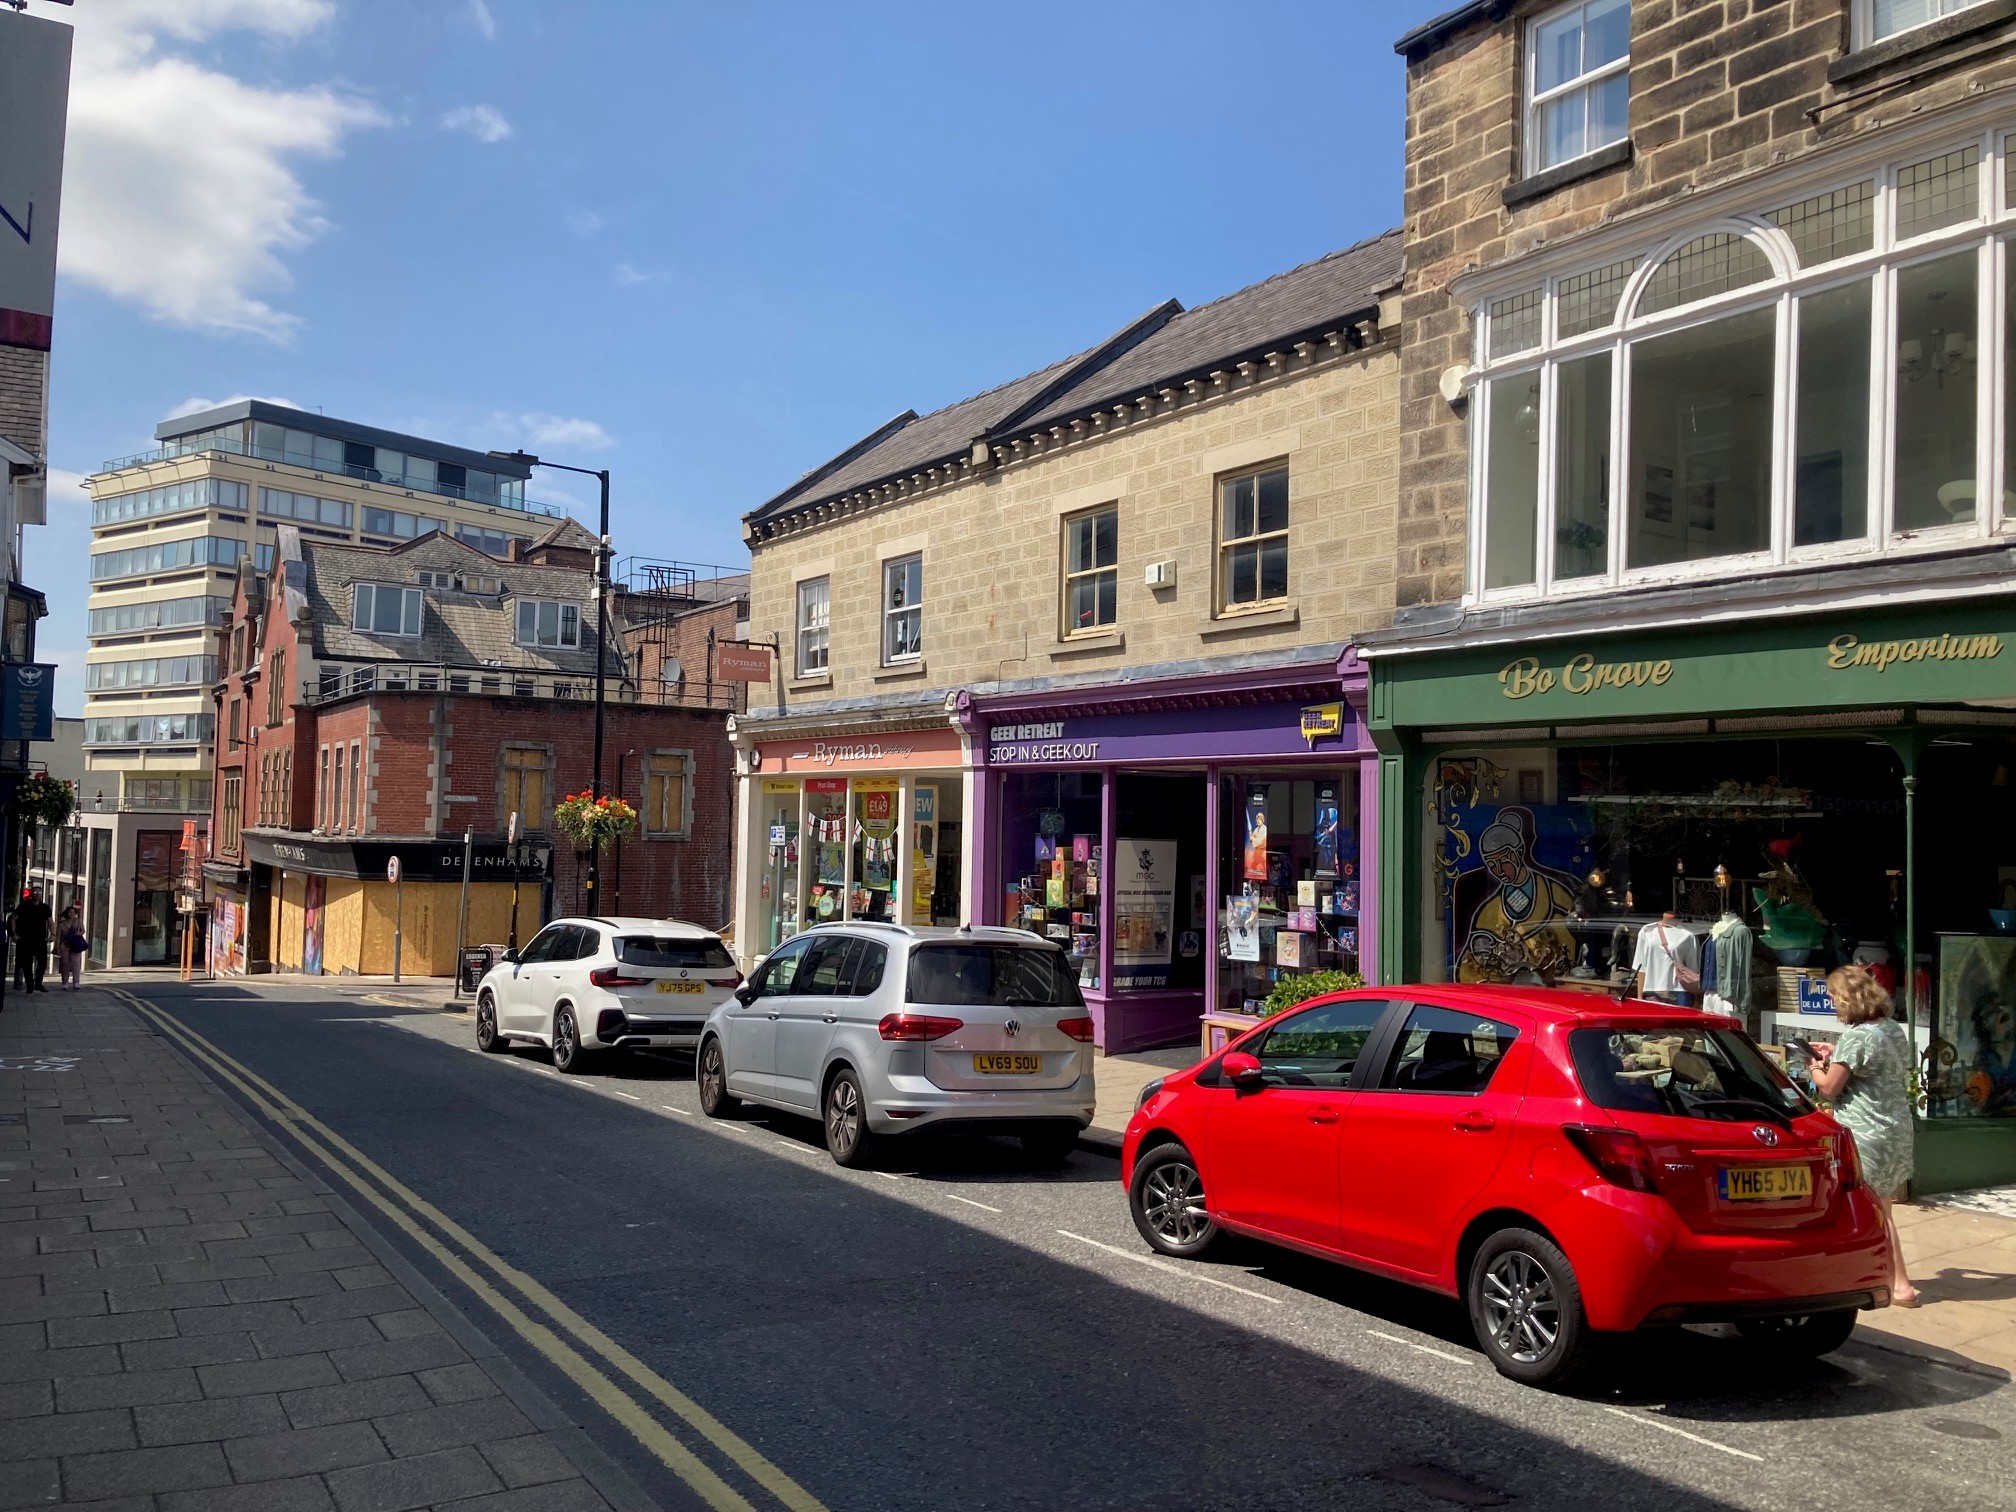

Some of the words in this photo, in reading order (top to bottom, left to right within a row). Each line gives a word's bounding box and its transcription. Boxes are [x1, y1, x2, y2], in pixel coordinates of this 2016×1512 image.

[1827, 633, 2004, 673] Emporium
[722, 657, 767, 668] Ryman
[1497, 656, 1557, 699] Bo
[1562, 653, 1674, 695] Grove
[1303, 719, 1334, 730] RETREAT
[990, 726, 1016, 741] GEEK
[1017, 722, 1065, 740] RETREAT
[813, 742, 884, 766] Ryman
[990, 746, 1016, 762] STOP
[1018, 746, 1029, 760] IN
[1031, 745, 1040, 760] &
[1041, 744, 1071, 759] GEEK
[1073, 743, 1099, 758] OUT
[827, 781, 836, 789] Shop
[442, 856, 540, 867] DEENHAMS
[1134, 976, 1153, 986] YOUR
[1153, 975, 1167, 986] TCG
[660, 983, 683, 992] YJ75
[685, 983, 702, 992] GPS
[1802, 1000, 1811, 1008] DE
[1812, 1001, 1821, 1009] LA
[1823, 998, 1838, 1010] PL
[980, 1056, 1012, 1070] LV69
[1014, 1056, 1038, 1070] SOU
[1730, 1169, 1774, 1194] YH65
[1779, 1169, 1808, 1192] JYA
